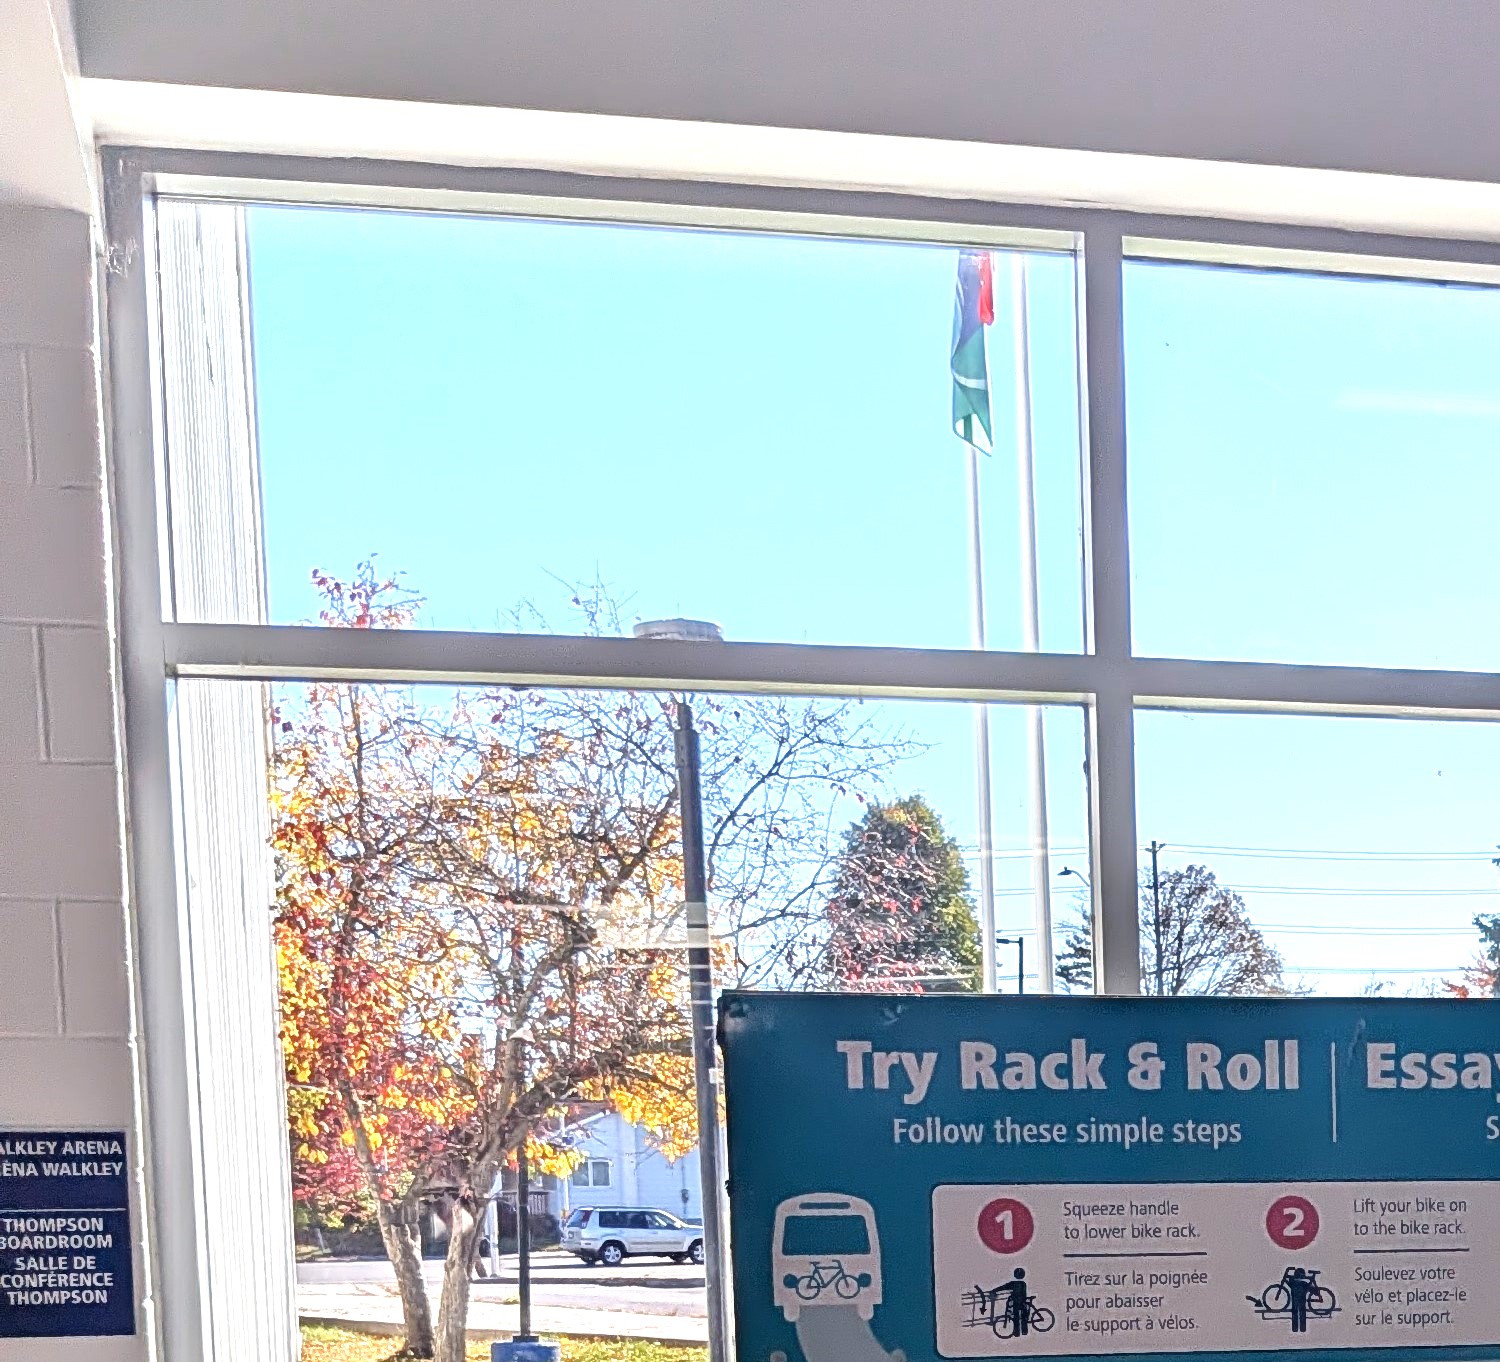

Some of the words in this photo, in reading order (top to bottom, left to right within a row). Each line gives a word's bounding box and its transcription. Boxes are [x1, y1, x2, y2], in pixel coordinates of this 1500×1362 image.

[836, 1039, 938, 1105] Try
[960, 1038, 1107, 1091] Rack
[1128, 1041, 1165, 1091] &
[1186, 1039, 1300, 1091] Roll
[894, 1117, 984, 1144] Follow
[994, 1117, 1066, 1144] these
[1076, 1117, 1164, 1150] simple
[1172, 1120, 1242, 1150] steps
[62, 1140, 122, 1155] ARENA
[0, 1160, 39, 1177] ÉNA
[42, 1162, 123, 1176] WALKLEY
[1064, 1201, 1125, 1220] Squeeze
[1130, 1200, 1179, 1215] handle
[1354, 1198, 1375, 1213] Lift
[1380, 1202, 1411, 1217] your
[1416, 1197, 1445, 1212] bike
[1449, 1200, 1467, 1212] on
[3, 1217, 104, 1233] THOMPSON
[994, 1210, 1015, 1238] 1
[1064, 1225, 1079, 1239] to
[1085, 1224, 1126, 1238] lower
[1131, 1224, 1162, 1238] bike
[1167, 1222, 1200, 1238] rack.
[1283, 1208, 1304, 1236] 2
[1354, 1223, 1368, 1235] to
[1373, 1220, 1396, 1235] the
[1401, 1219, 1429, 1235] bike
[1434, 1219, 1465, 1235] rack.
[0, 1234, 113, 1250] BOARDROOM
[15, 1256, 68, 1271] SALLE
[73, 1256, 96, 1270] DE
[0, 1271, 114, 1288] CONFÉRENCE
[1064, 1271, 1100, 1286] Tirez
[1105, 1274, 1127, 1285] sur
[1133, 1270, 1144, 1285] la
[1150, 1269, 1208, 1289] poignée
[1355, 1266, 1416, 1281] Soulevez
[1420, 1267, 1455, 1280] votre
[7, 1290, 108, 1305] THOMPSON
[1066, 1297, 1101, 1312] pour
[1105, 1293, 1164, 1308] abaisser
[1355, 1288, 1383, 1303] vélo
[1388, 1289, 1402, 1303] et
[1407, 1287, 1467, 1306] placez-le
[1067, 1316, 1079, 1331] le
[1084, 1317, 1141, 1336] support
[1146, 1316, 1154, 1330] à
[1158, 1314, 1199, 1330] vélos.
[1355, 1314, 1376, 1326] sur
[1381, 1310, 1392, 1324] le
[1397, 1310, 1454, 1328] support.
